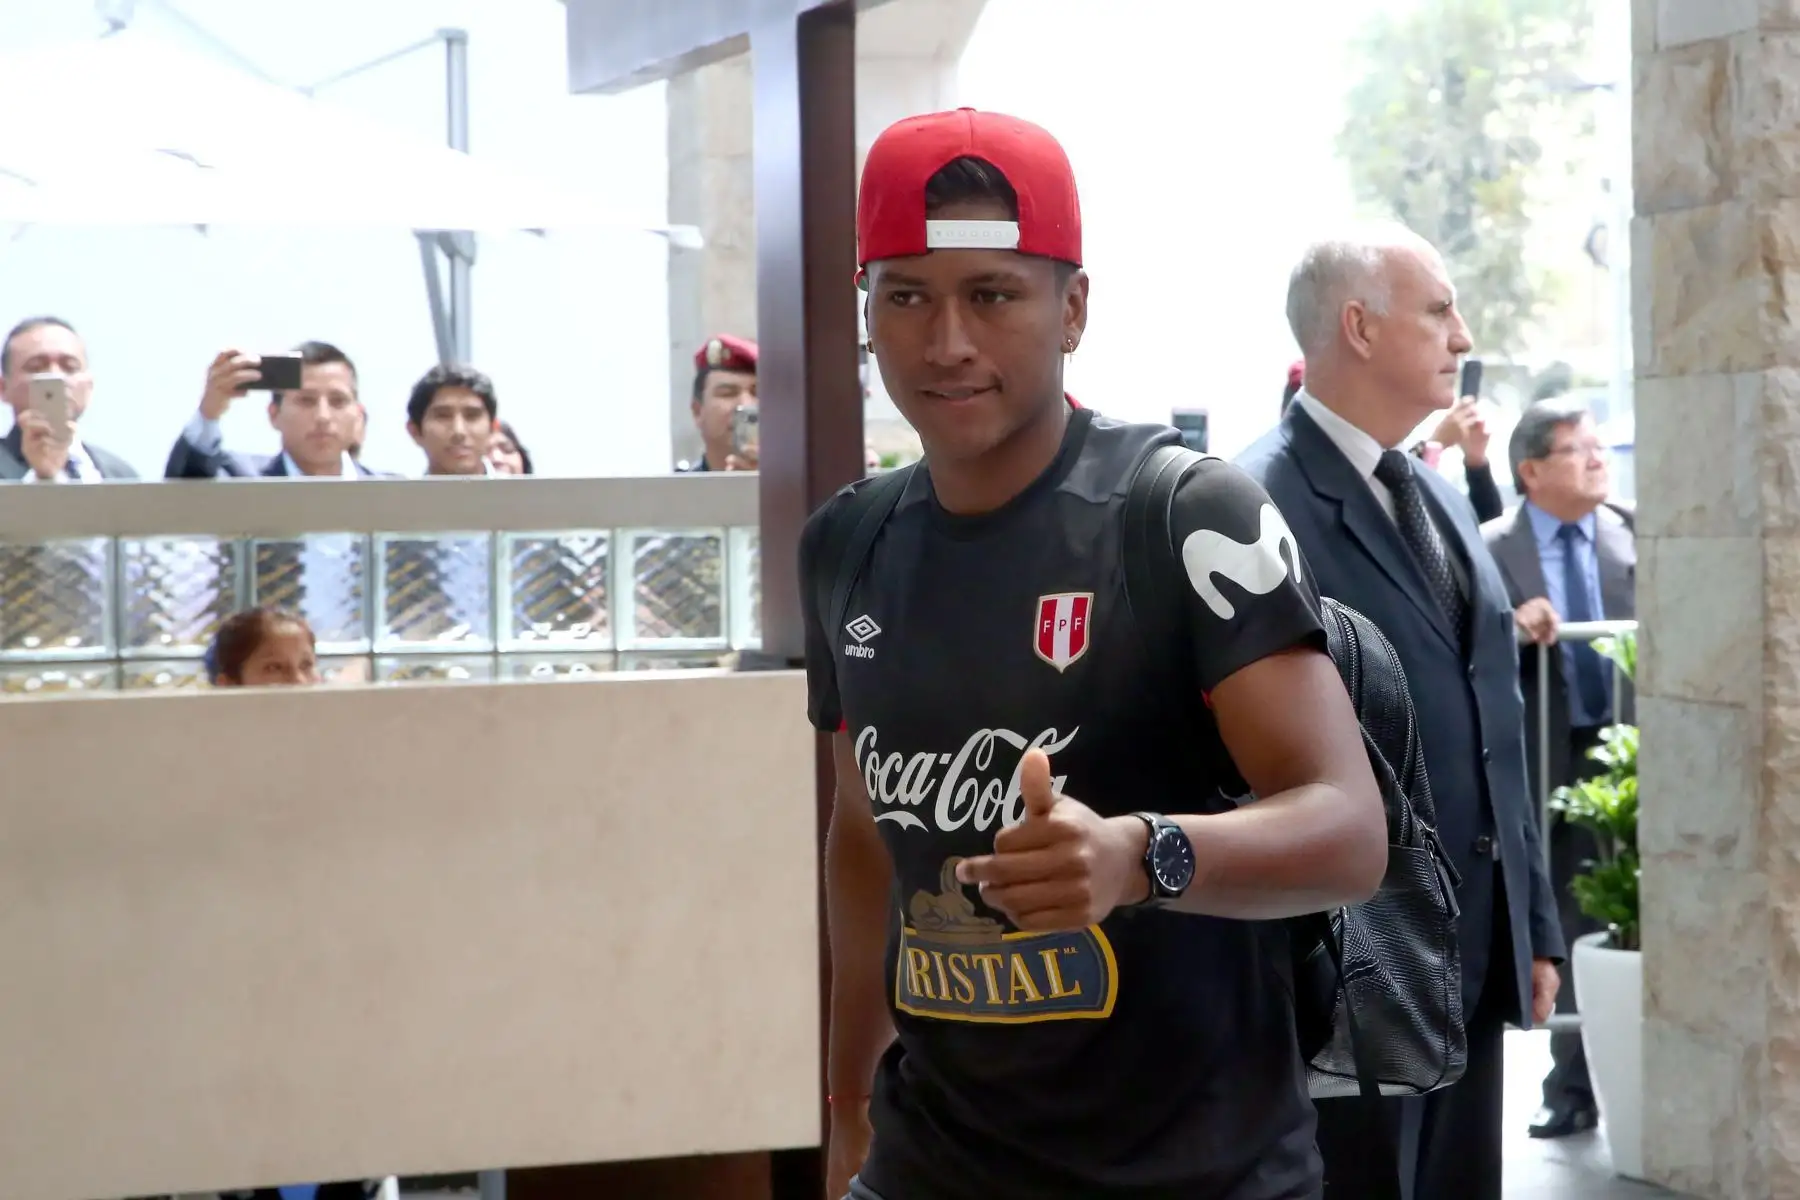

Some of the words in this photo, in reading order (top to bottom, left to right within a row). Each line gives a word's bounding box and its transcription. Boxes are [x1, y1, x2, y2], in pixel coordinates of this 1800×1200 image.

[844, 643, 875, 659] umbro
[854, 725, 1080, 832] Coca-Col
[906, 948, 1081, 1004] RISTAL
